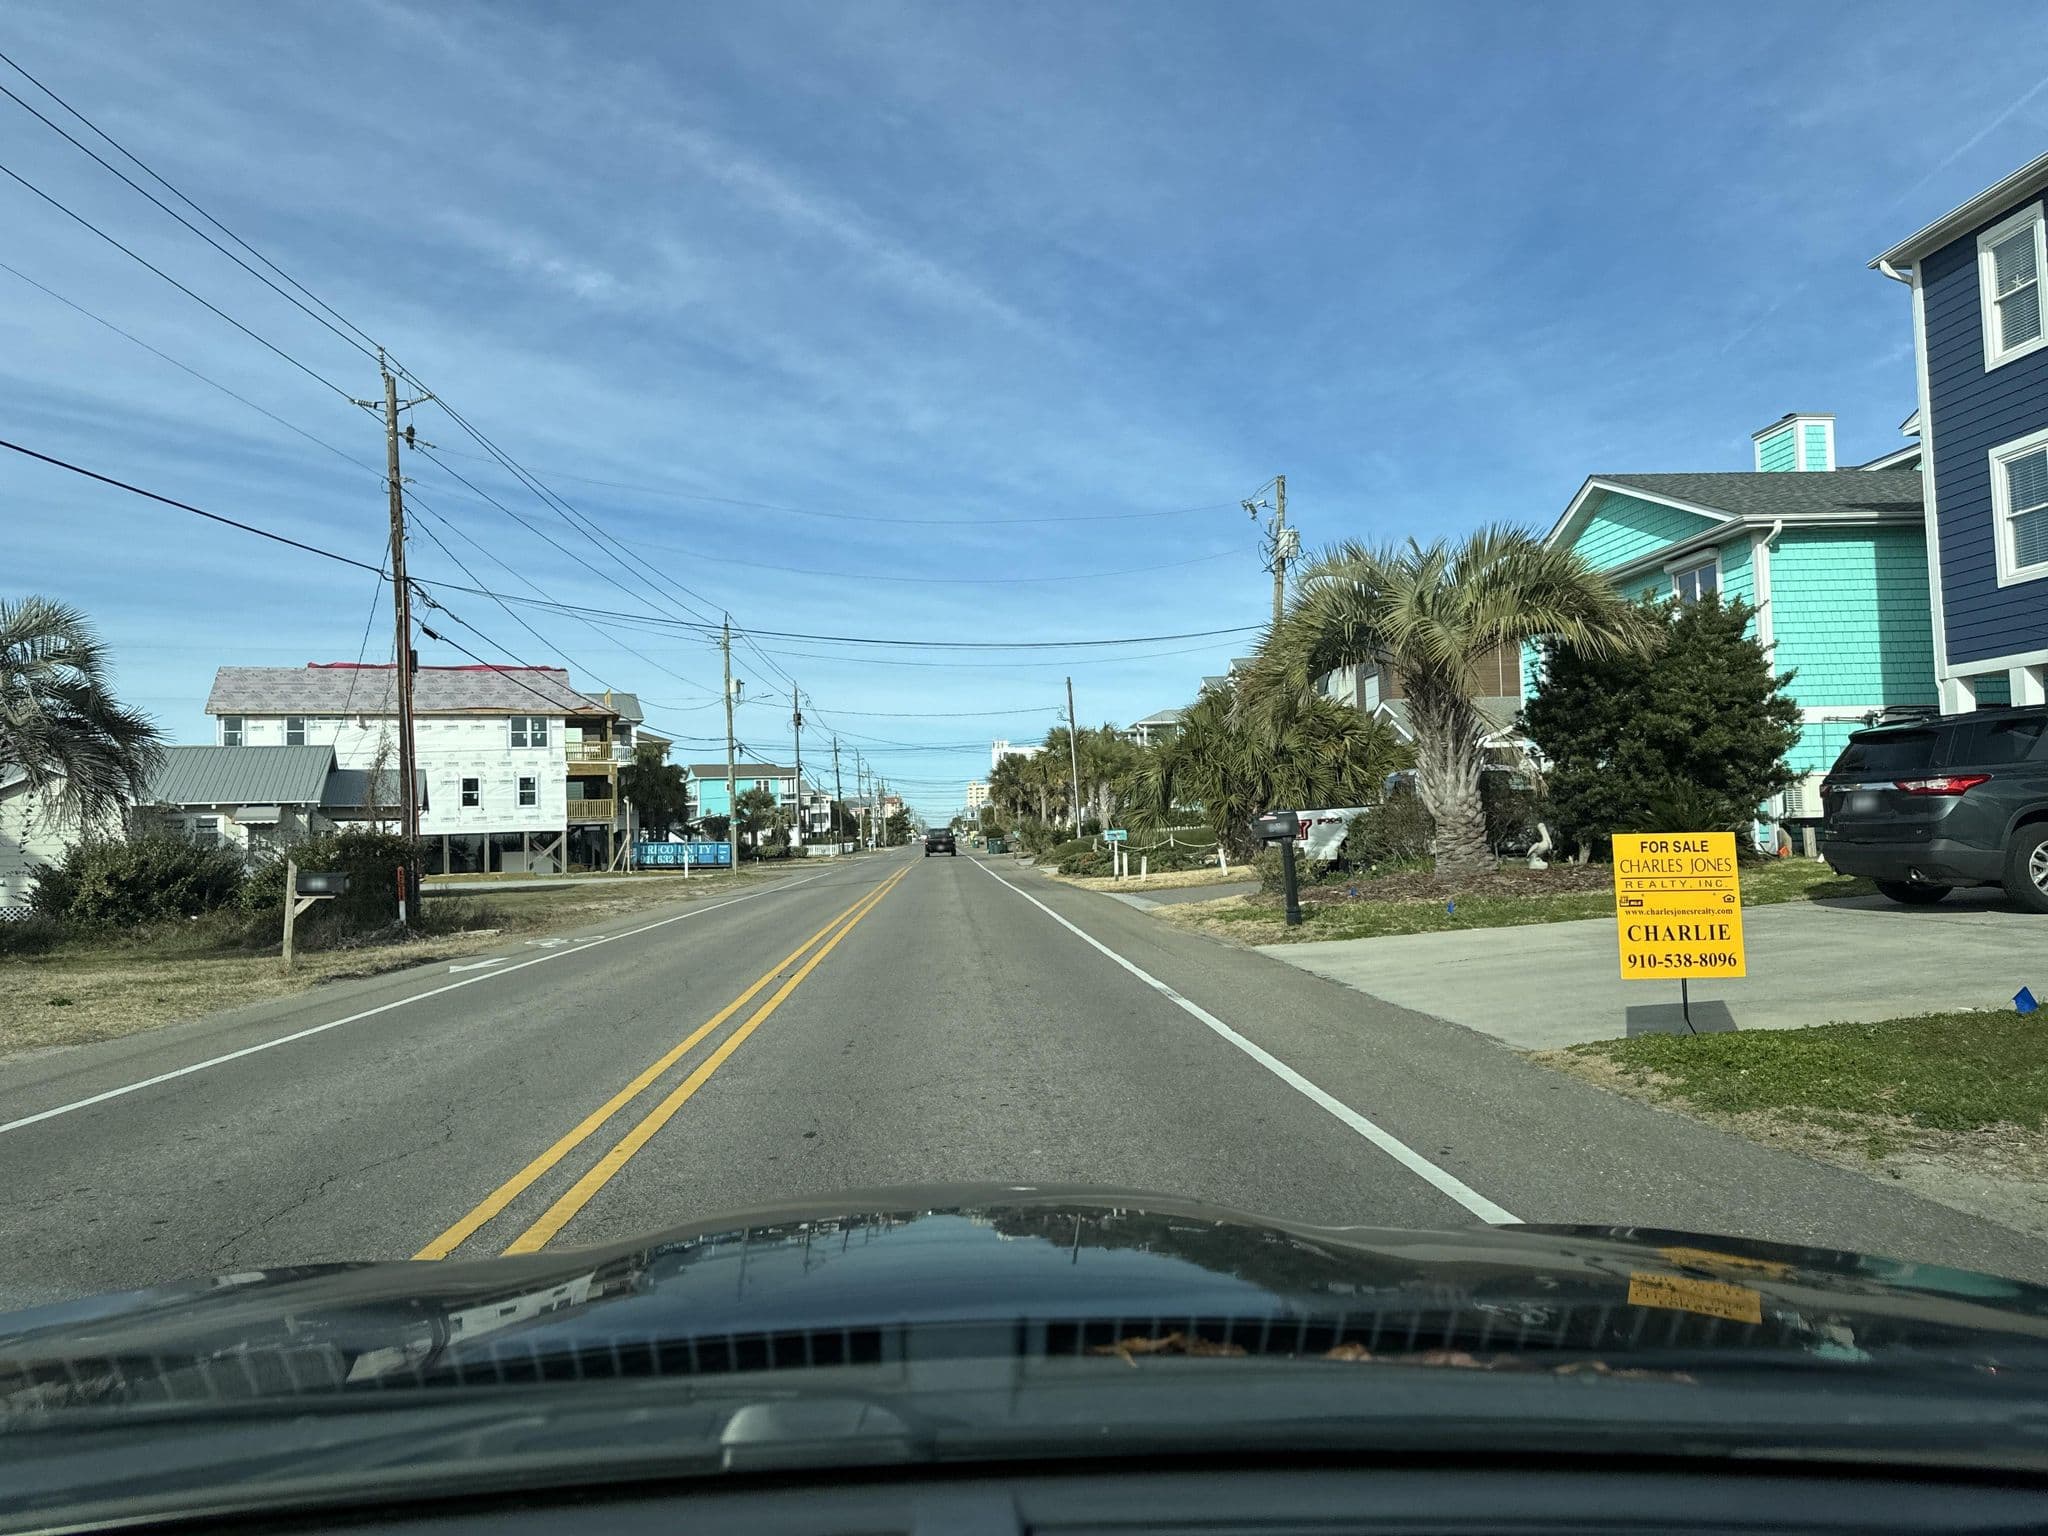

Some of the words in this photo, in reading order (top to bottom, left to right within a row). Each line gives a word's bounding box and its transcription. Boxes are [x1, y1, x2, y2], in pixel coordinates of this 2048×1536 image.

[640, 845, 657, 855] TRI
[1640, 841, 1669, 853] FOR
[1672, 840, 1709, 853] SALE
[1620, 858, 1683, 873] CHARLES
[1689, 857, 1732, 874] JONES
[1699, 879, 1729, 888] INC.
[1625, 907, 1733, 917] www.charlesjonesrealty.com
[1627, 924, 1731, 942] CHARLIE
[1628, 952, 1737, 969] 910-538-8096
